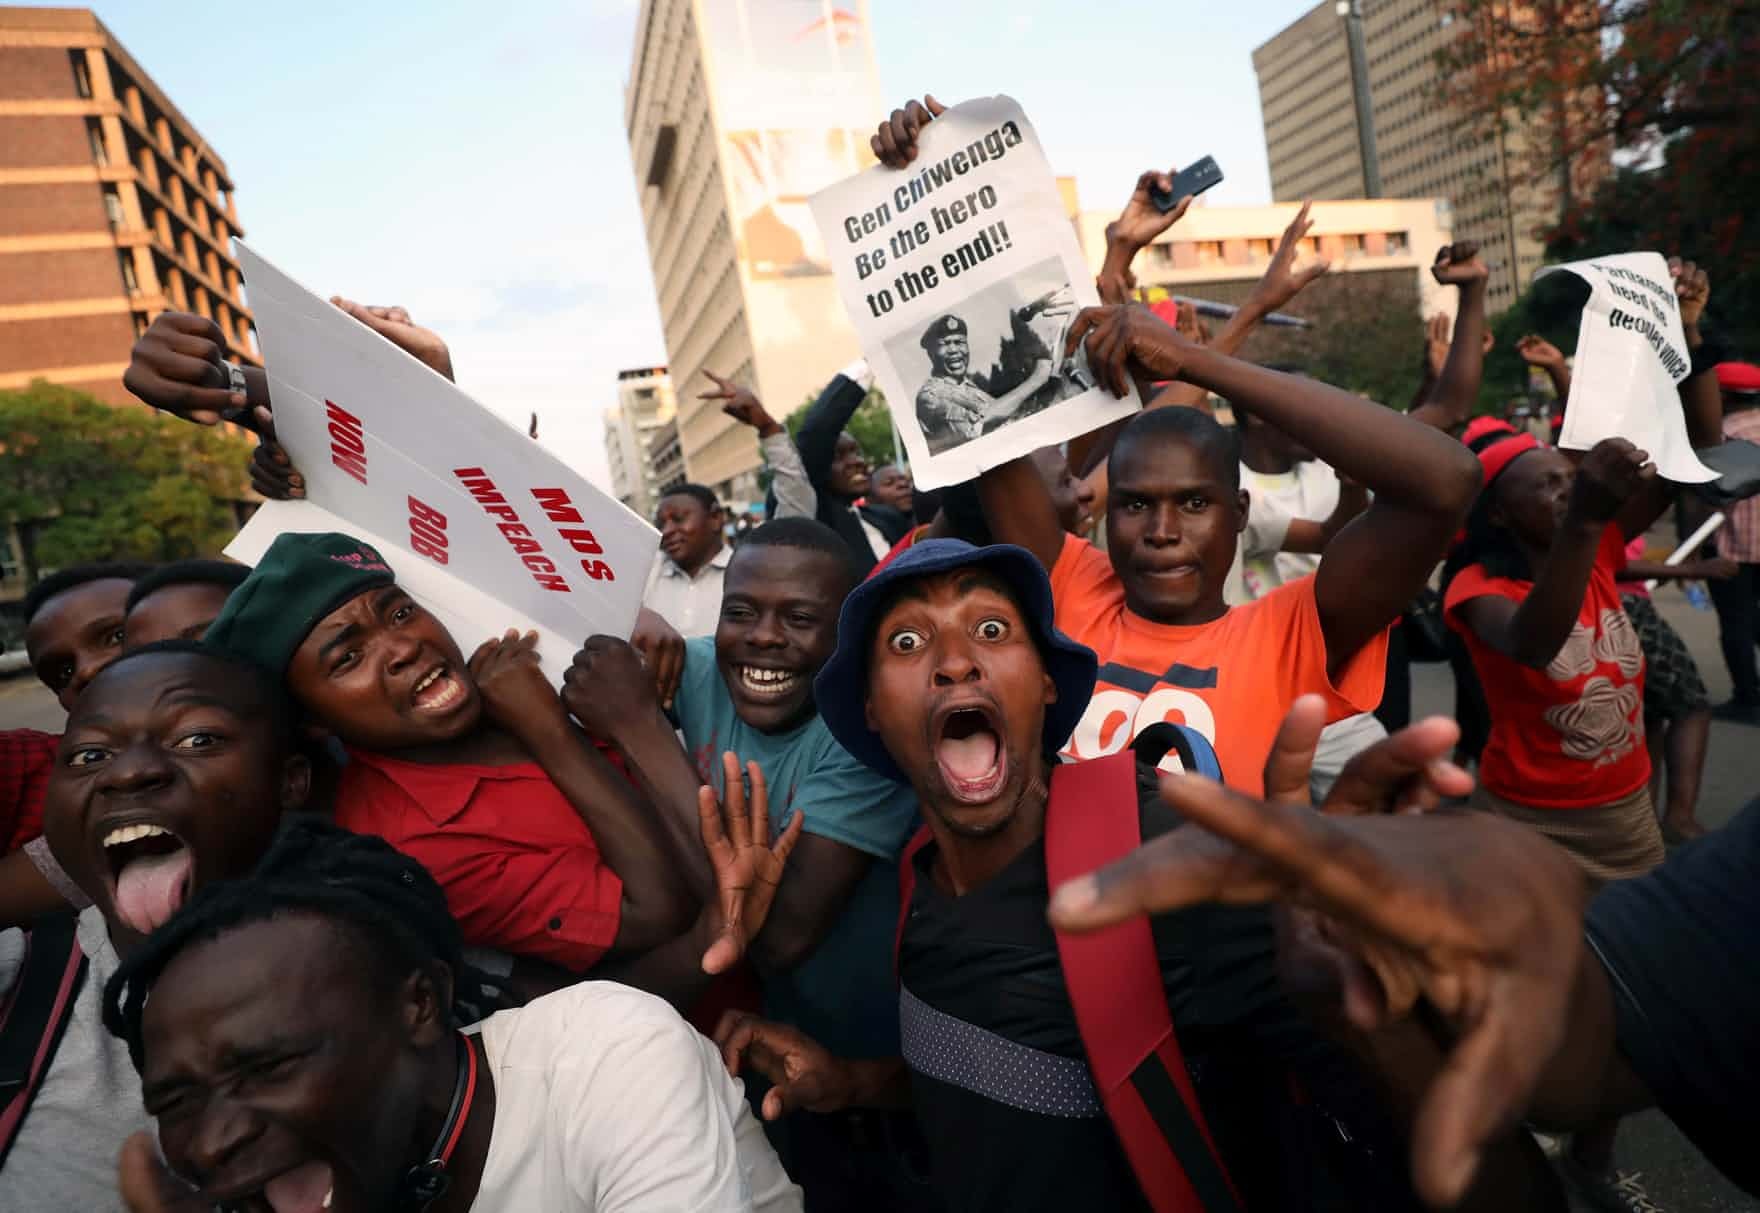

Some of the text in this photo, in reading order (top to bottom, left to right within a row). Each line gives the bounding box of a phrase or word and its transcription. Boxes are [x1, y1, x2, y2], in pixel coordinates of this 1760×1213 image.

[844, 120, 1023, 243] Gen Chiwenga
[855, 185, 997, 281] Be the hero
[866, 221, 1012, 318] to the end!!
[1658, 342, 1688, 378] voice
[326, 399, 368, 486] NOW
[408, 495, 449, 566] BOB
[454, 467, 571, 593] IMPEACH
